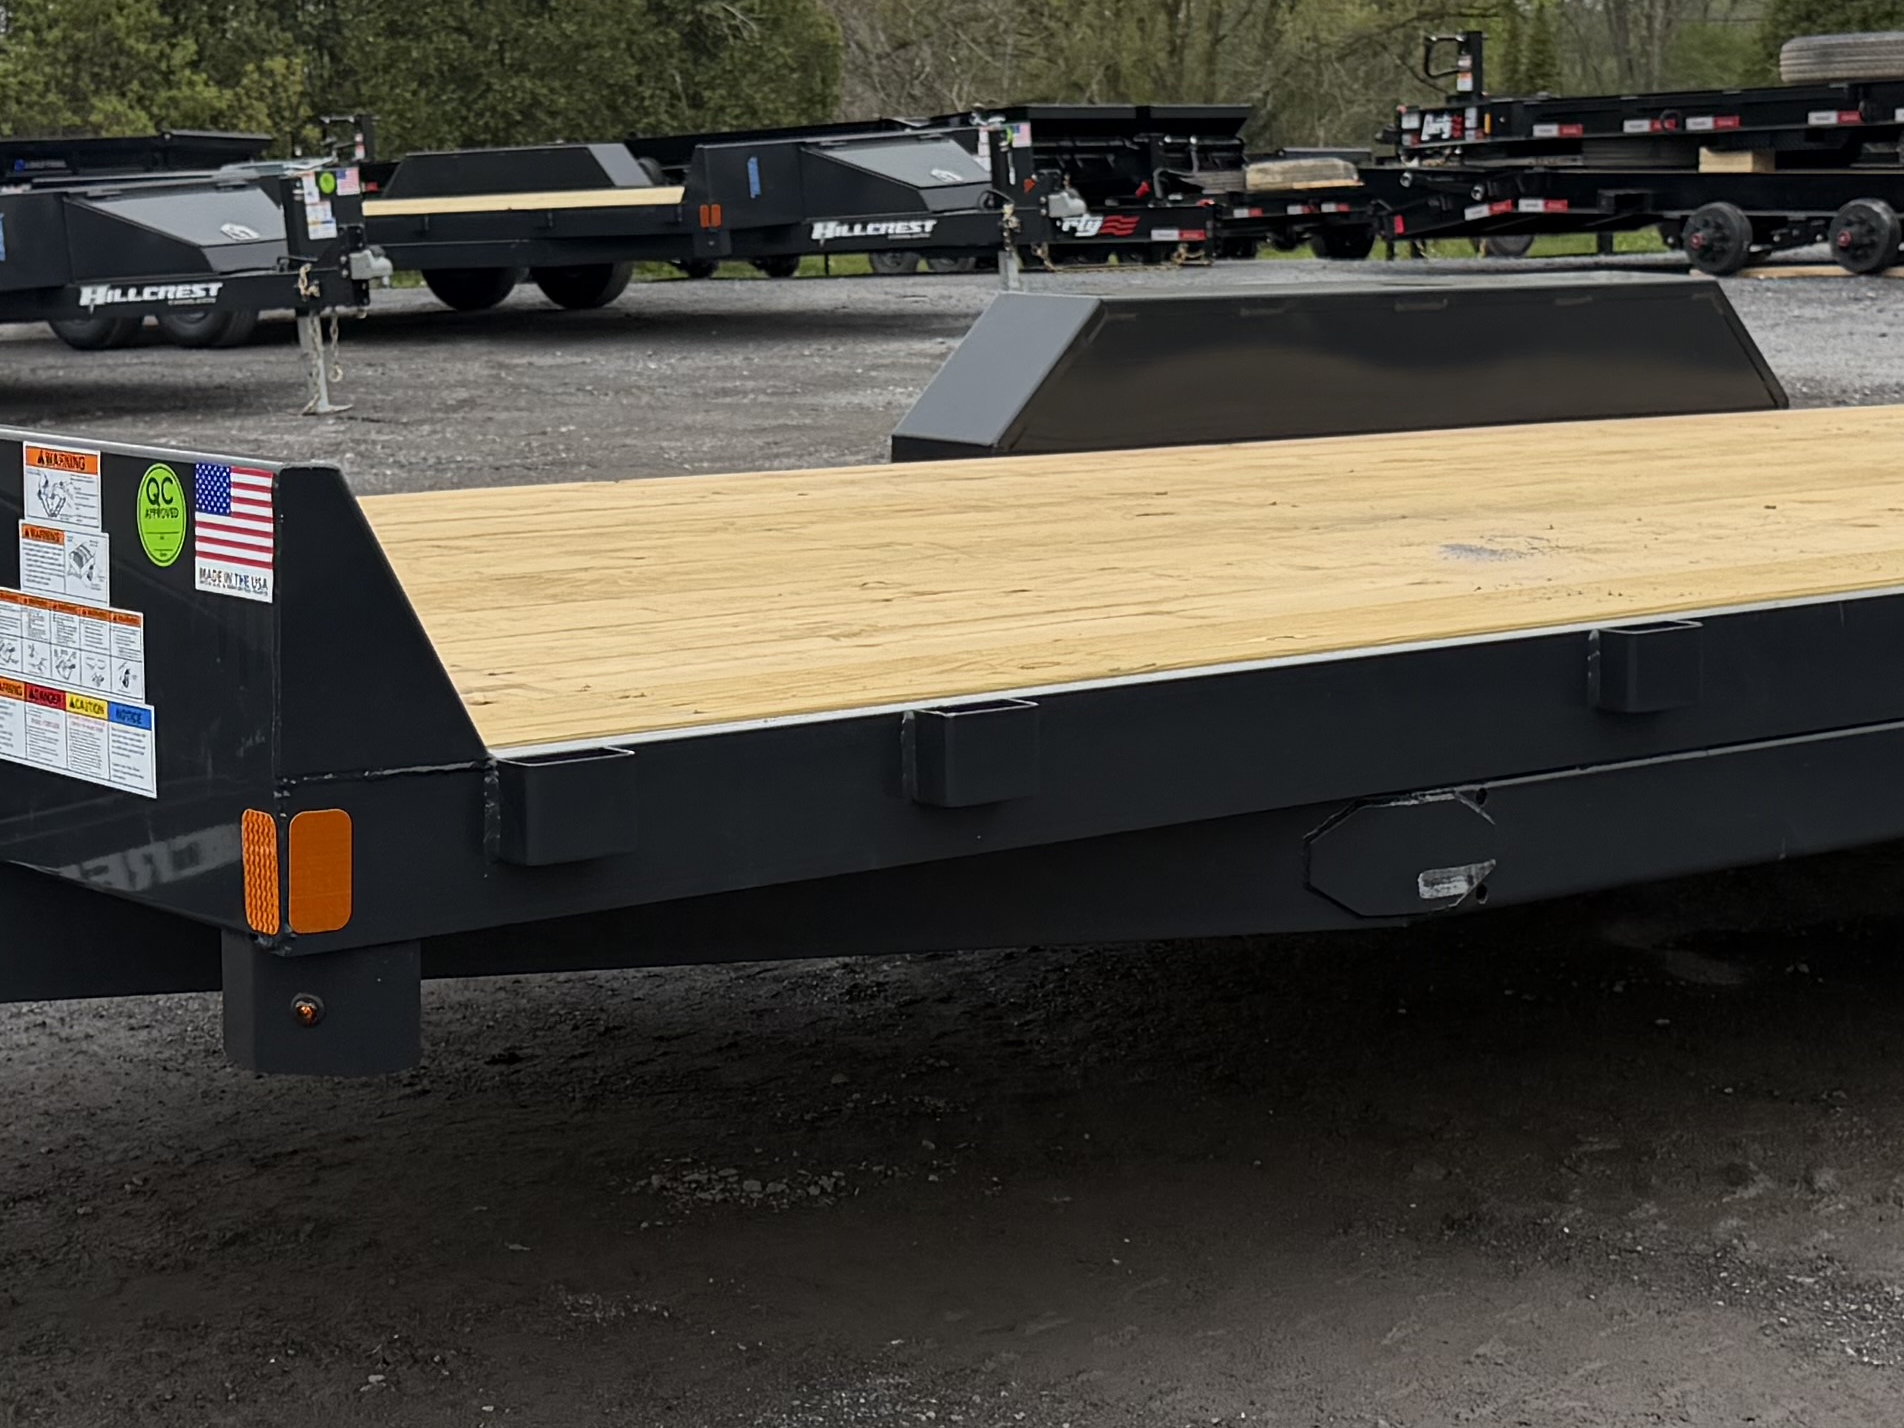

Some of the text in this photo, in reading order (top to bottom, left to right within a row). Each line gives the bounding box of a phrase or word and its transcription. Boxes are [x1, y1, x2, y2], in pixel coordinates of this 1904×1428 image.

[811, 220, 936, 240] HILLCREST
[79, 282, 223, 306] HILLCREST
[45, 453, 85, 471] WARNING
[146, 476, 174, 507] QC
[144, 506, 179, 520] APPROVED
[199, 567, 222, 583] MADE
[223, 570, 233, 586] IN
[251, 576, 269, 591] USA
